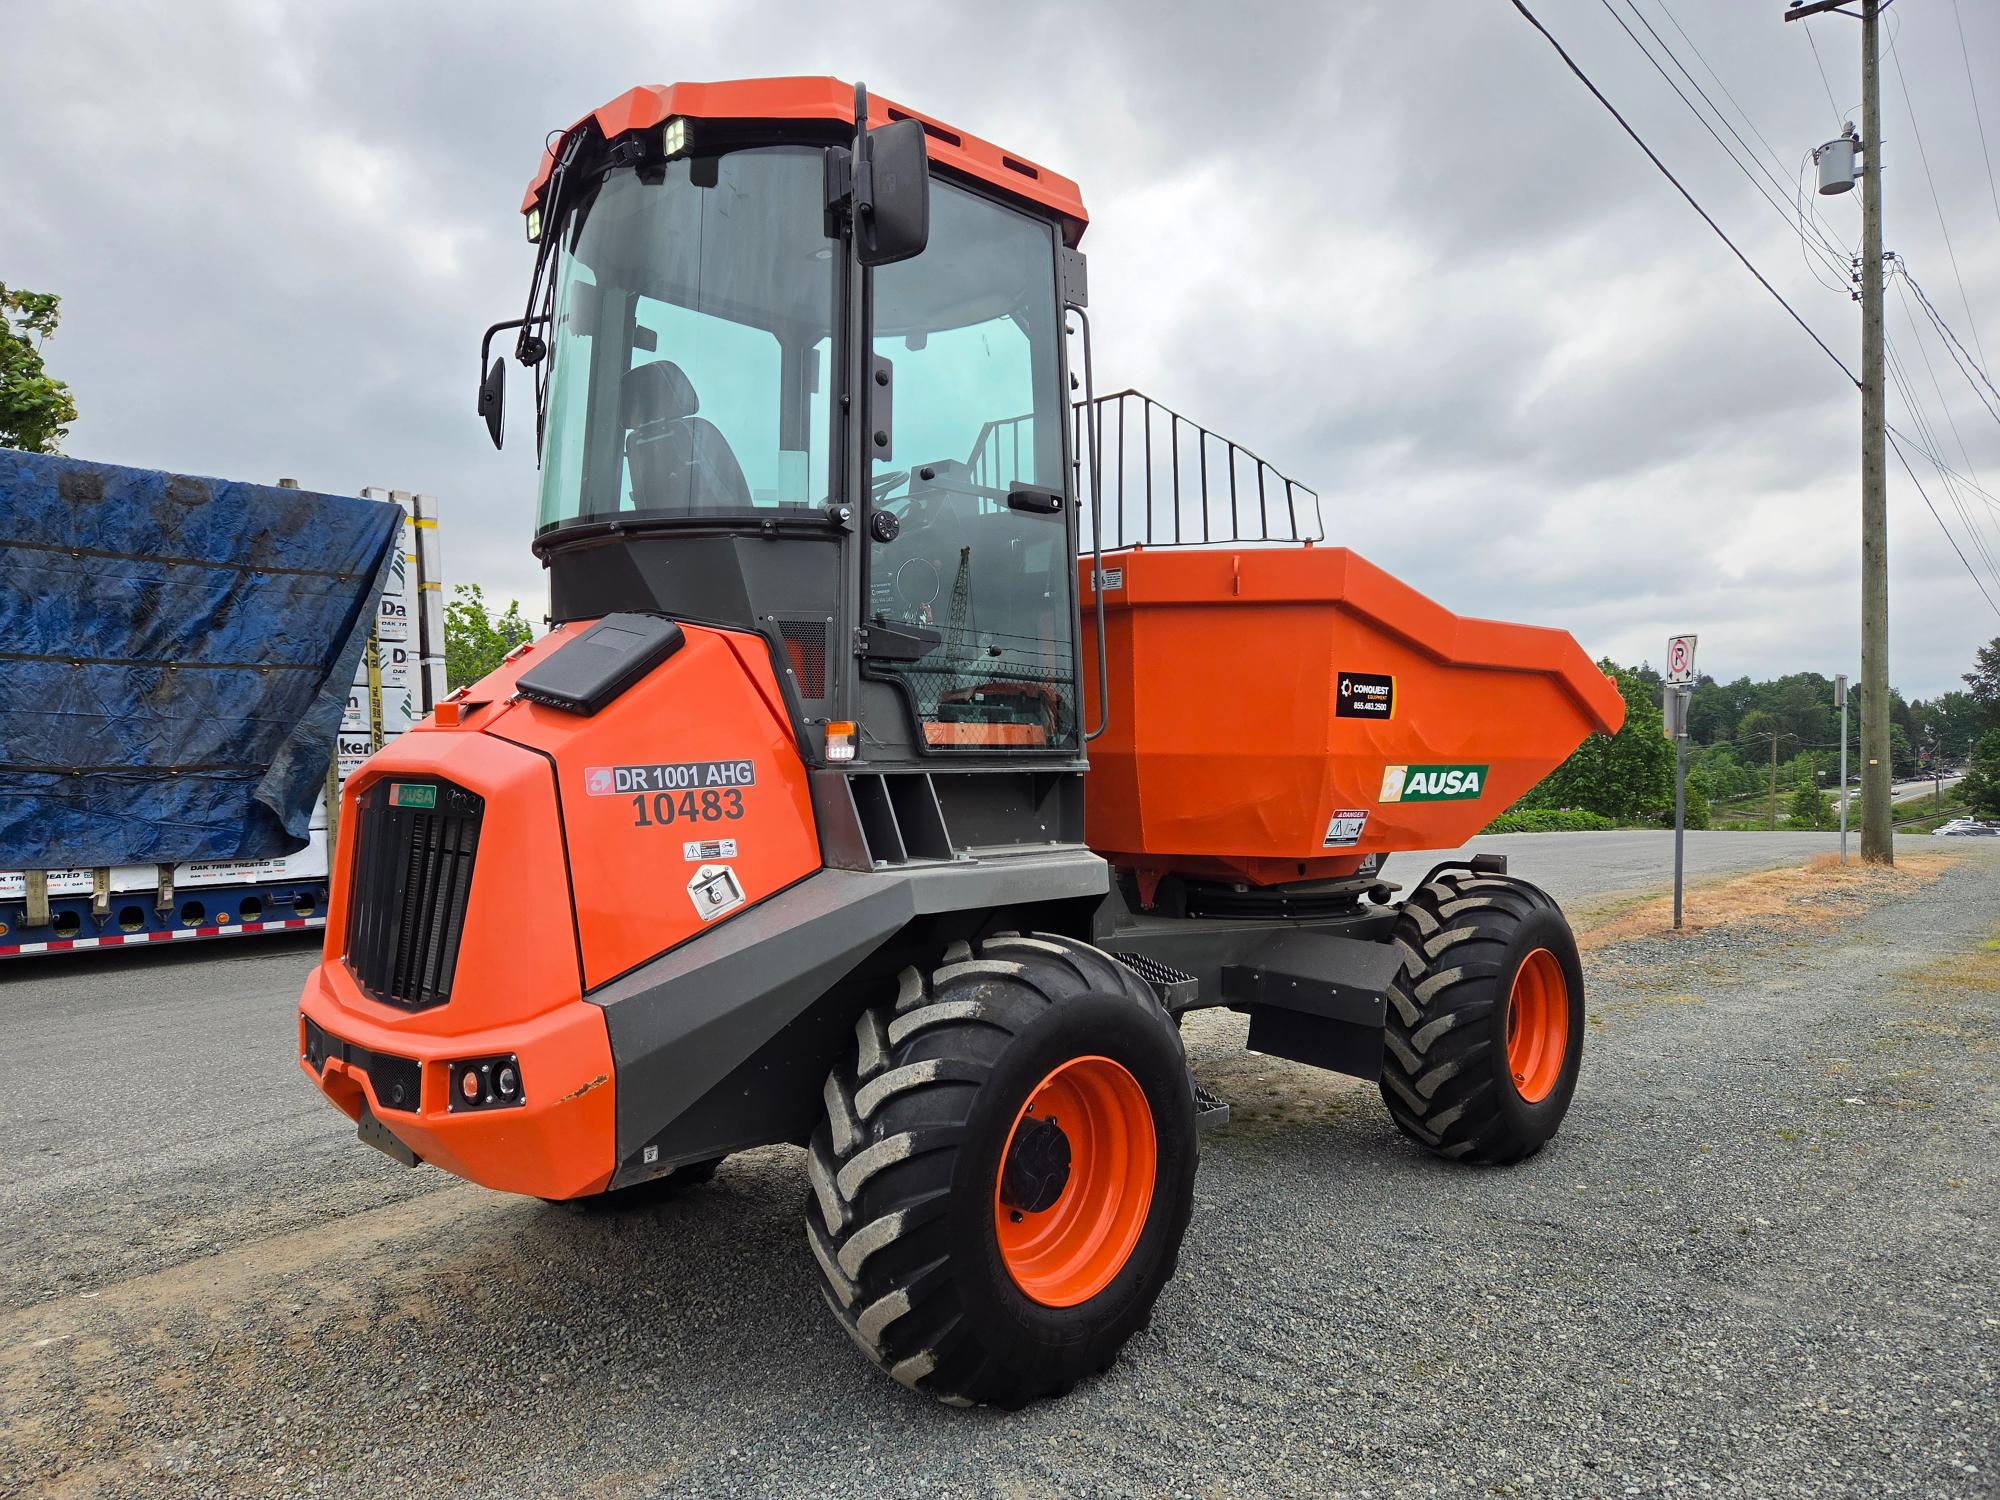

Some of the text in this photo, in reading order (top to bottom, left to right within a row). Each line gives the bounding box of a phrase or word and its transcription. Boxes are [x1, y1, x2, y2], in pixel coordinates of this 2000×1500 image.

[1353, 684, 1390, 695] CONQUEST
[614, 762, 752, 791] DR 1001 AHG
[1404, 770, 1480, 795] AUSA
[632, 788, 745, 827] 10483
